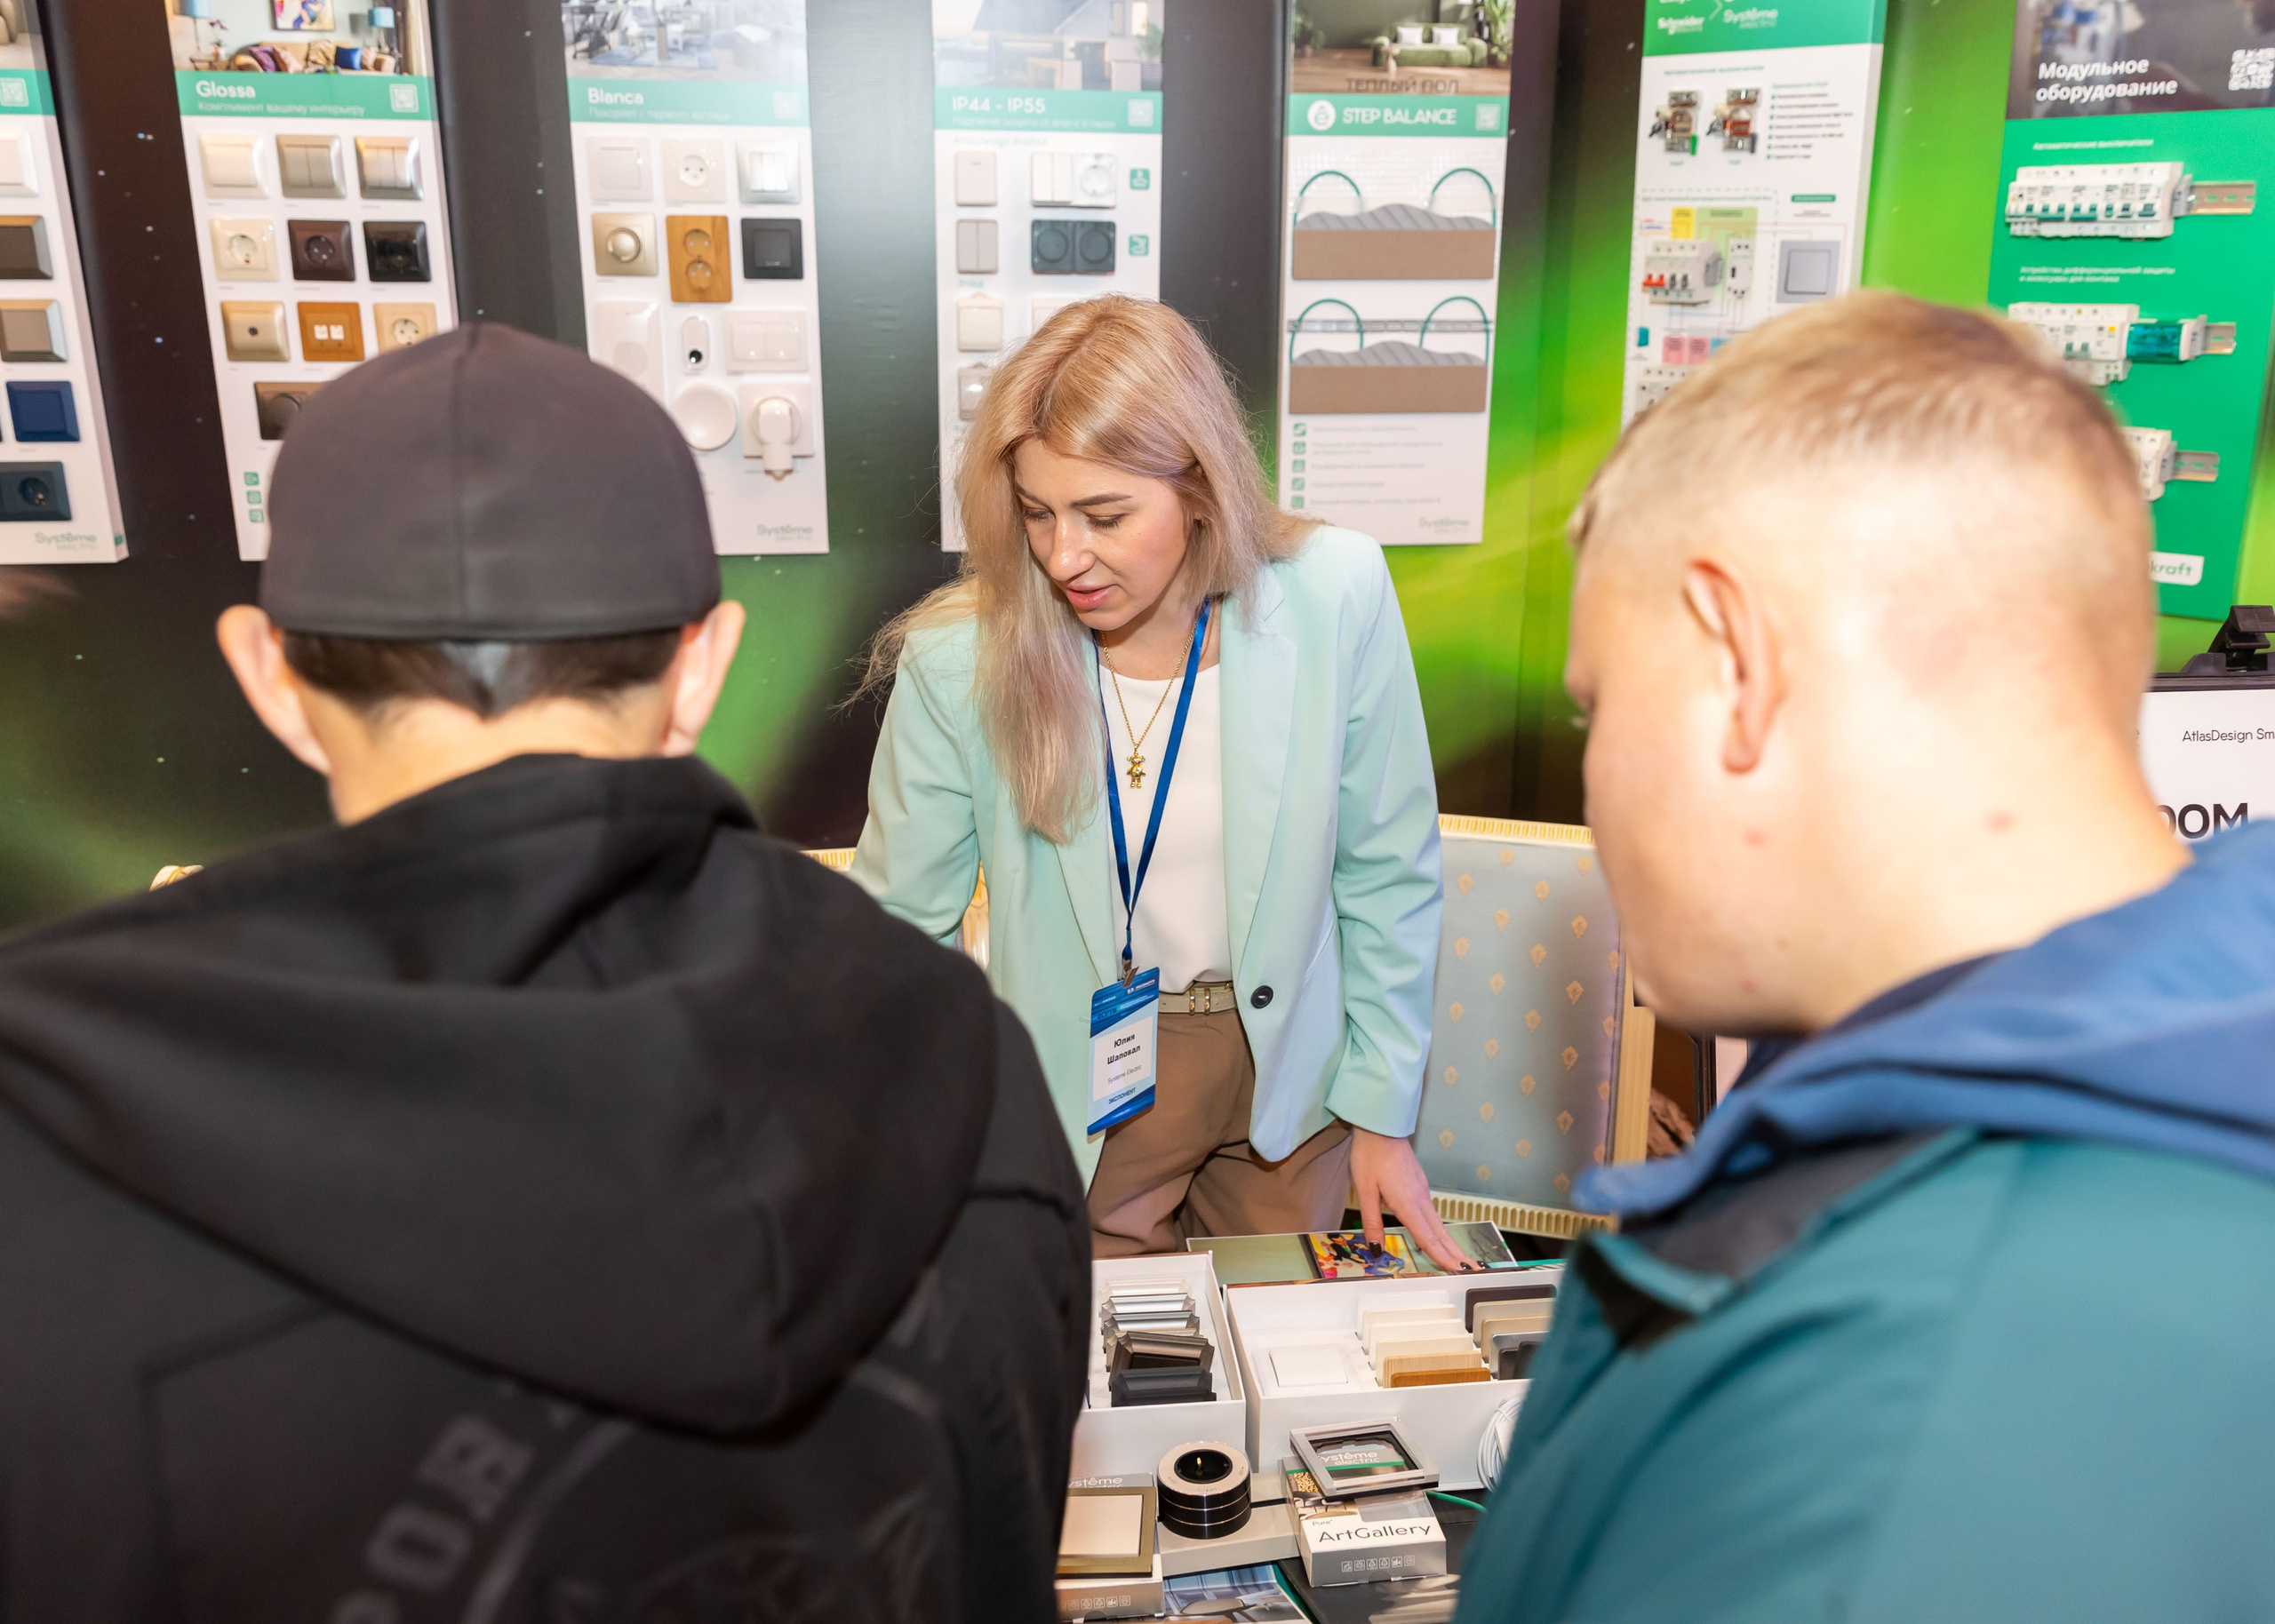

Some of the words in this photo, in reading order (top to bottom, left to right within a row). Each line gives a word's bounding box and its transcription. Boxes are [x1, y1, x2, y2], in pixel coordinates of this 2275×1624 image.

[2039, 59, 2150, 81] Модульное
[196, 80, 256, 99] Glossa
[1346, 76, 1417, 93] ТЕПЛЫЙ
[1422, 78, 1459, 94] ПОЛ
[2036, 80, 2178, 104] оборудование
[587, 87, 644, 106] Blanca
[952, 96, 991, 112] IP44
[1008, 98, 1047, 114] IP55
[1342, 107, 1381, 124] STEP
[1384, 108, 1457, 125] BALANCE
[2151, 559, 2192, 577] kraft
[2182, 729, 2254, 743] AtlasDesign
[2256, 728, 2275, 740] Sm
[1114, 1034, 1135, 1048] Юлия
[1107, 1045, 1141, 1065] Шаповал
[1107, 1071, 1126, 1084] Systeme
[1127, 1064, 1142, 1076] Electric
[1108, 1087, 1136, 1104] ЭКСПОНЕНТ
[1319, 1452, 1378, 1463] ystême
[1068, 1477, 1123, 1488] ystême
[1319, 1524, 1431, 1543] ArtGallery
